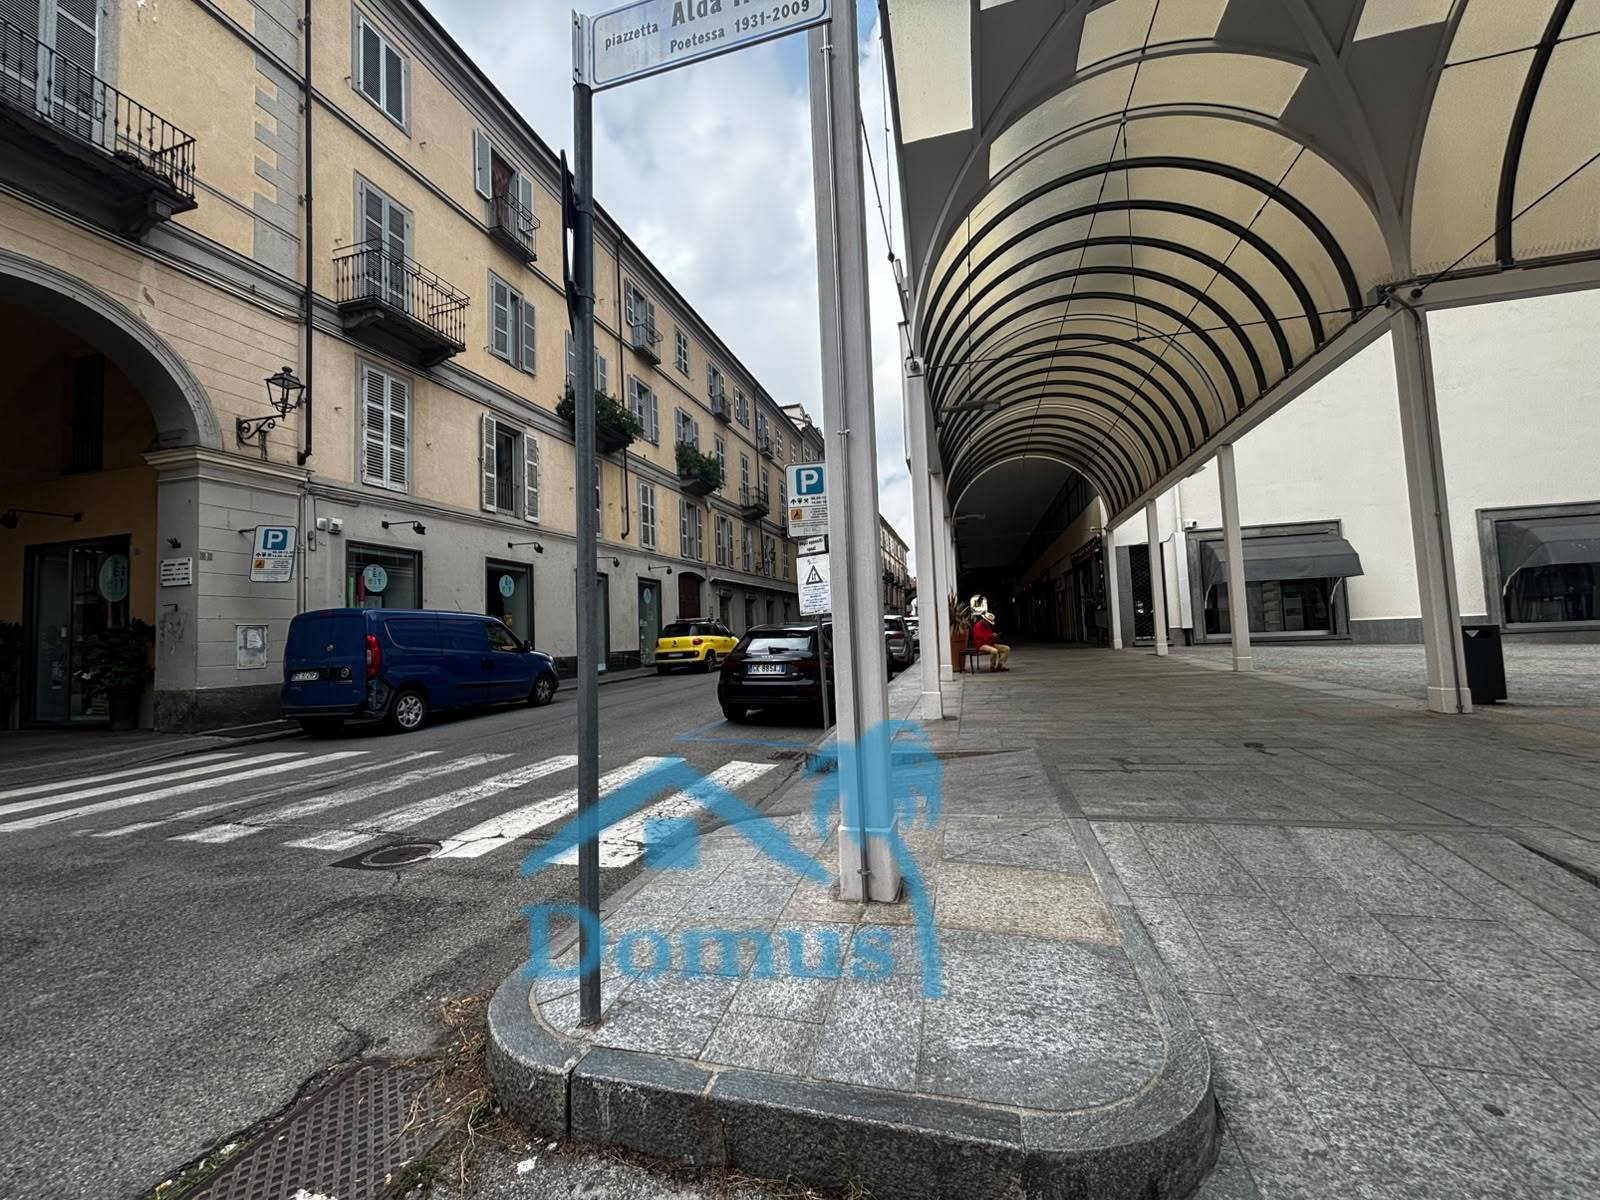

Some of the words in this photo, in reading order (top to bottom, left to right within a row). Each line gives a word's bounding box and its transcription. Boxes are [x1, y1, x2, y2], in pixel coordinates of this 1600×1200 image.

[670, 26, 725, 53] Poetessa
[735, 0, 810, 32] 1931-2009
[671, 0, 722, 27] Alda
[604, 21, 659, 50] piazzetta
[800, 469, 819, 493] P
[267, 530, 283, 549] P
